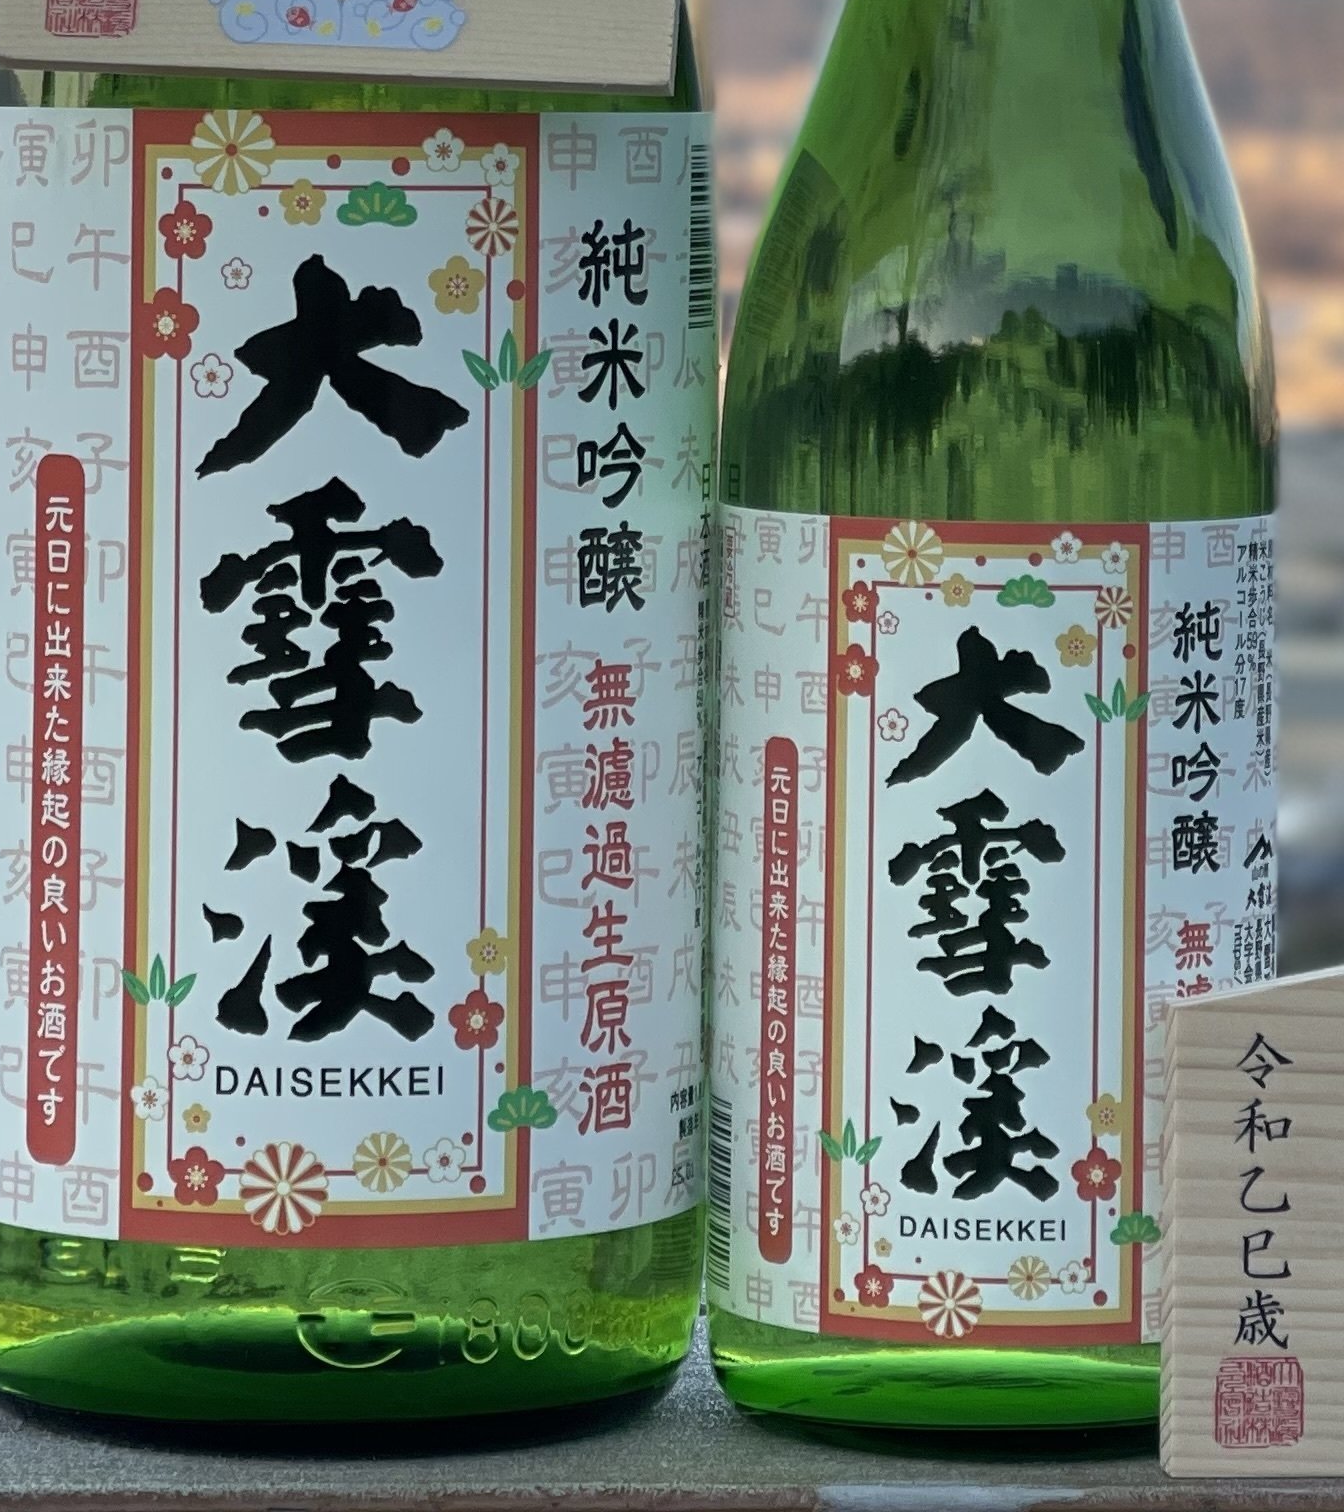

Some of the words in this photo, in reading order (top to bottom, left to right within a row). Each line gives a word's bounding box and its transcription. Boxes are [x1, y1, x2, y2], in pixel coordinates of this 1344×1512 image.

[577, 218, 648, 614] 純米吟醸
[36, 495, 75, 1127] 元日に出来た縁起の良いお酒です
[195, 253, 471, 1043] 大雪渓
[1171, 600, 1223, 875] 純米吟醸
[1233, 544, 1247, 720] アルコール分17度
[214, 1065, 445, 1098] DAISEKKEI
[578, 658, 639, 1136] 無濾過生原酒
[763, 766, 793, 1238] 元日に出来た縁起の良いお酒です
[884, 625, 1086, 1202] 大雪渓
[899, 1214, 1067, 1243] DAISEKKEI
[1232, 1031, 1294, 1351] 令和乙巳歳
